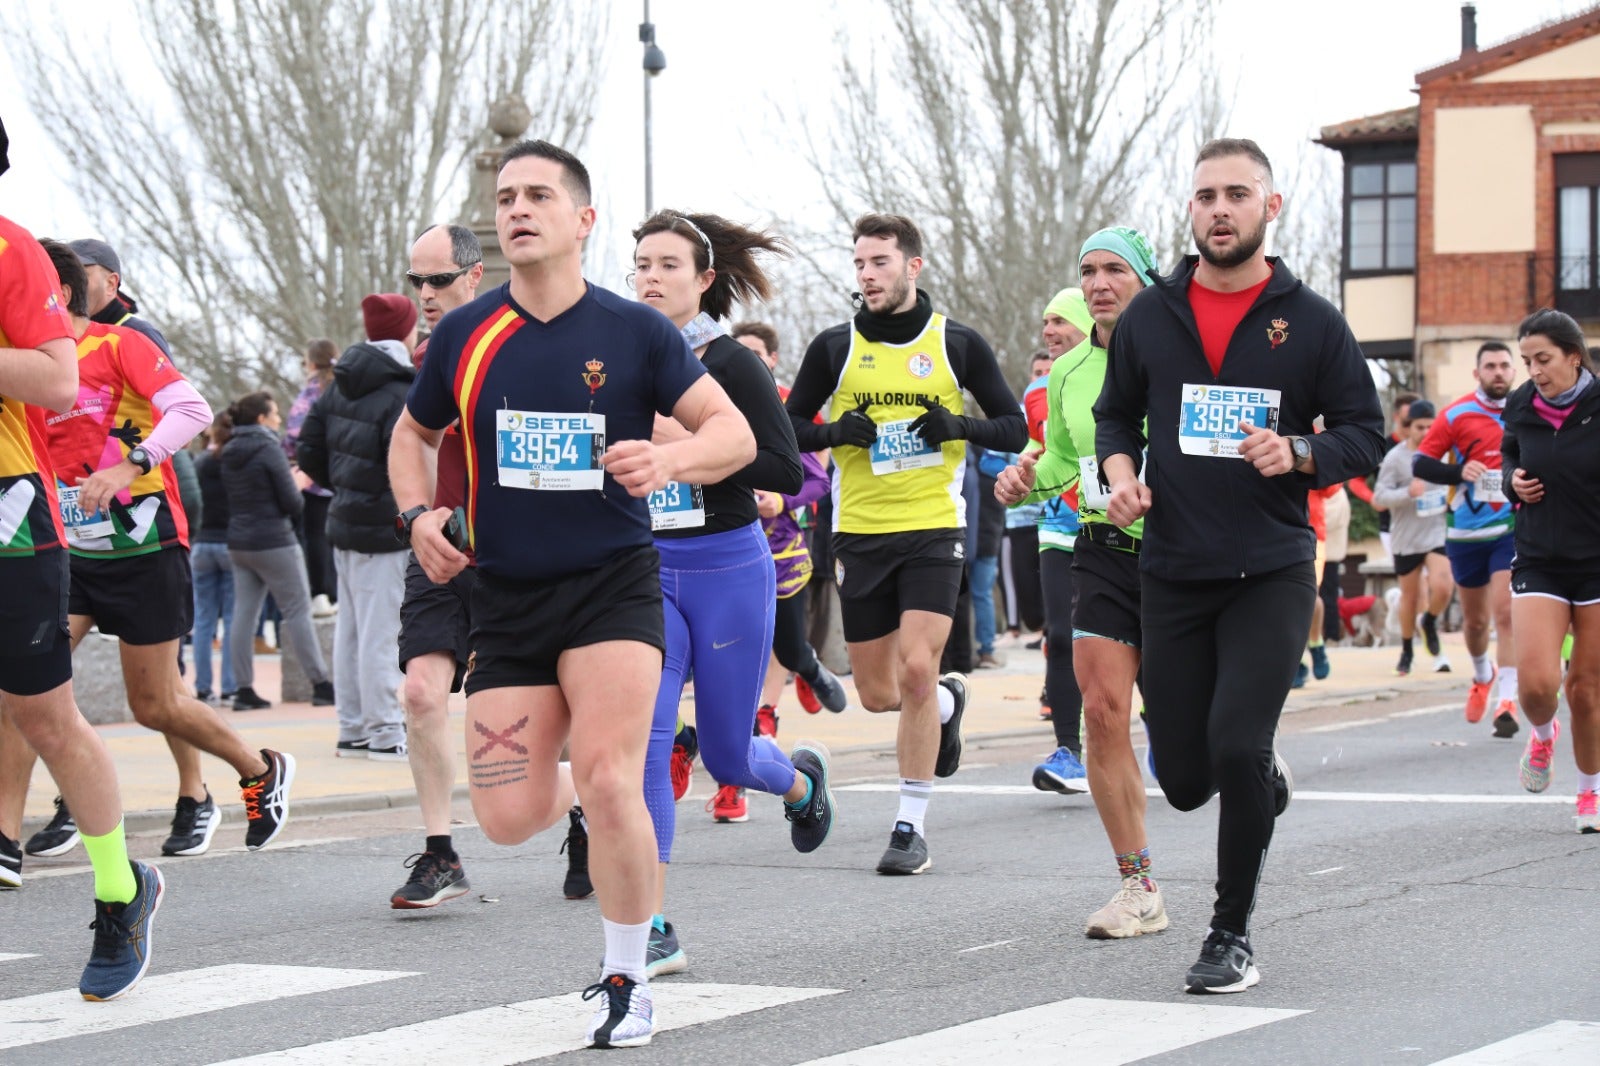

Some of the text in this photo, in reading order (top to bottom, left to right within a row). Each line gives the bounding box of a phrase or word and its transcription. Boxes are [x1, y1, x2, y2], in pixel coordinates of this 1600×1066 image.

[1208, 390, 1270, 404] SETEL
[525, 417, 594, 430] SETEL
[1193, 404, 1255, 434] 3956
[885, 421, 912, 433] SET
[511, 432, 579, 465] 3954
[1482, 478, 1503, 492] 169
[63, 489, 79, 500] SET
